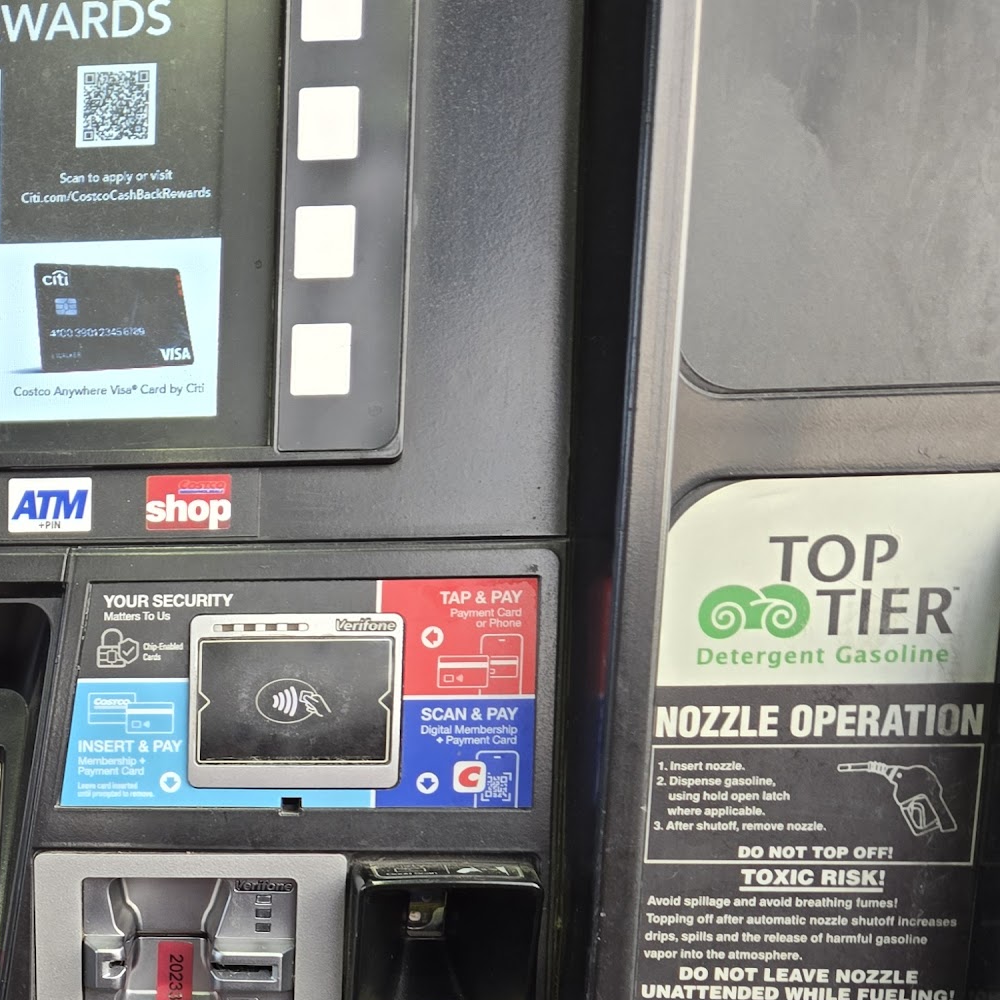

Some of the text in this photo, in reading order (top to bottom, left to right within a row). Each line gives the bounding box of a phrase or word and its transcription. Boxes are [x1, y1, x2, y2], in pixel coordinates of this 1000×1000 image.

[59, 169, 173, 185] Scan to apply or visit
[21, 187, 211, 204] Citi.com/CostcoCashBackRewards
[160, 347, 191, 360] VISA
[14, 386, 51, 396] Costco
[54, 385, 107, 398] Anywhere
[141, 384, 166, 395] Card
[170, 383, 182, 396] by
[186, 383, 205, 393] Citi
[11, 489, 89, 520] ATM
[146, 493, 232, 531] shop
[769, 534, 899, 583] TOP
[104, 594, 233, 608] YOUR SECURITY
[440, 590, 523, 604] TAP & PAY
[104, 611, 170, 621] Matters To Us
[450, 608, 522, 618] Payment Card
[336, 618, 397, 631] Verifone
[697, 645, 949, 669] Detergent Gasoline
[421, 707, 518, 721] SCAN & PAY
[655, 703, 985, 738] NOZZLE OPERATION
[421, 726, 518, 736] Digital Membership
[78, 740, 182, 752] INSERT & PAY
[658, 761, 746, 771] 1. Insert nozzle.
[738, 846, 893, 859] DO NOT TOP OFF!
[741, 869, 886, 886] TOXIC RISK!
[647, 896, 898, 910] Avoid spillage and avoid breathing fumes!
[679, 967, 918, 984] DO NOT LEAVE NOZZLE
[641, 984, 779, 1000] UNATTENDED
